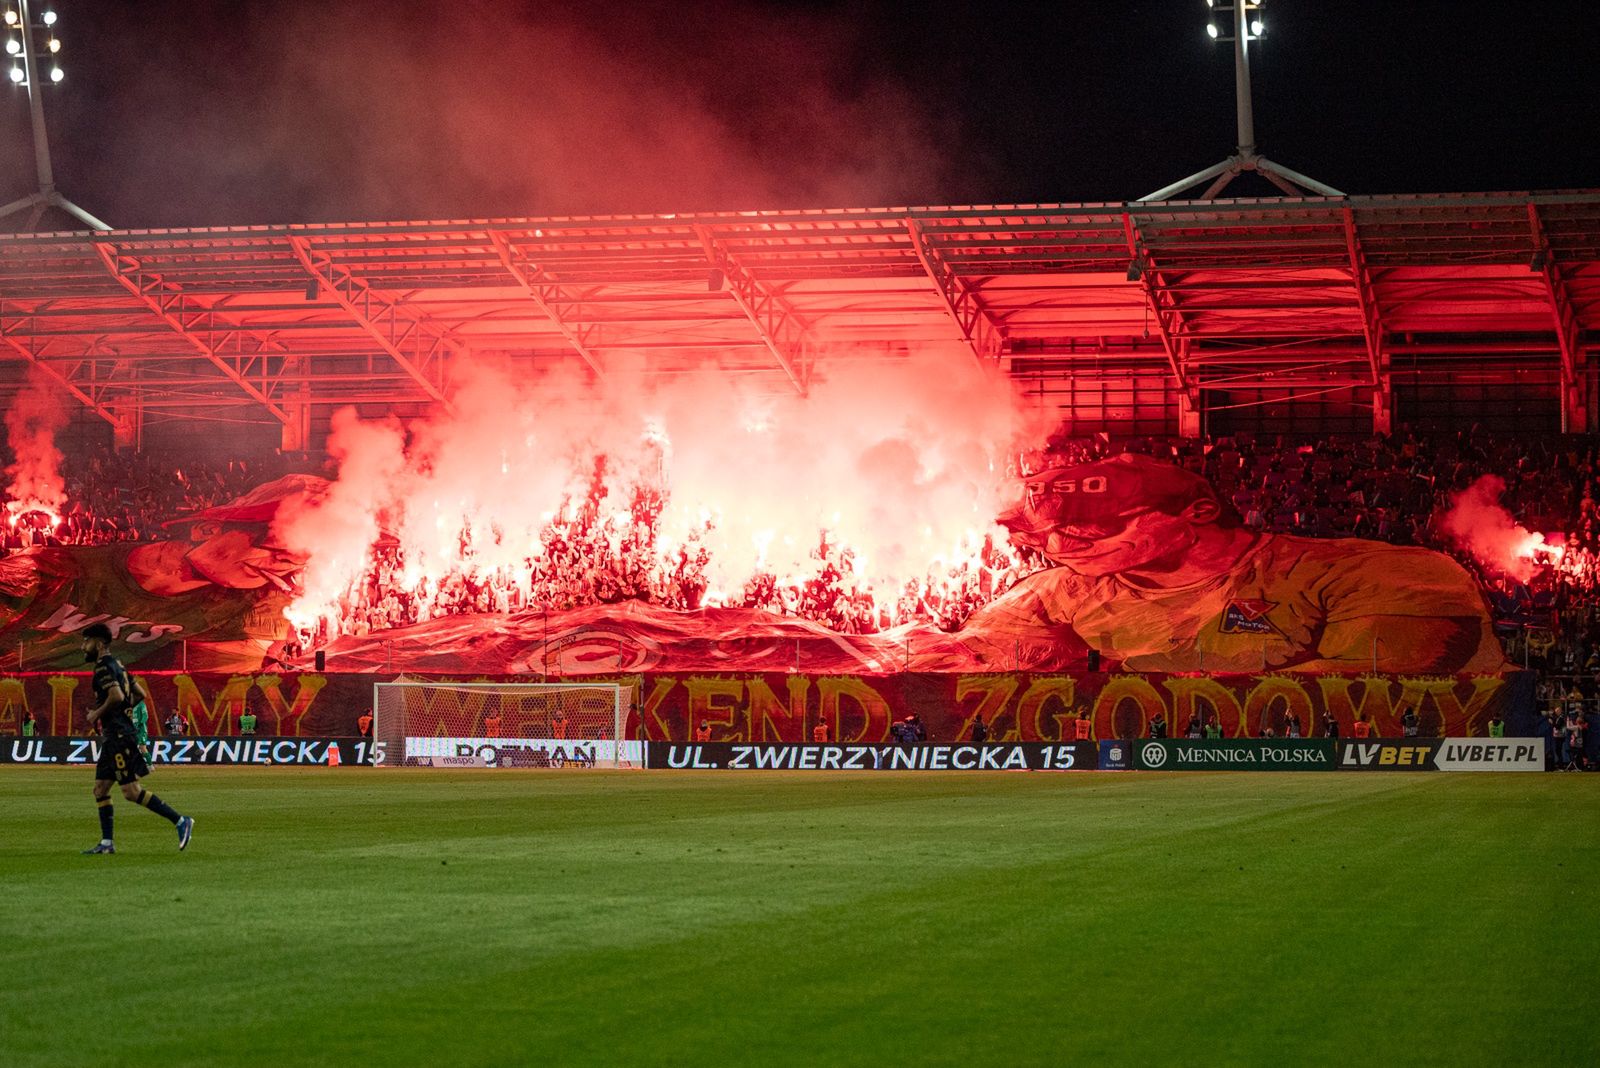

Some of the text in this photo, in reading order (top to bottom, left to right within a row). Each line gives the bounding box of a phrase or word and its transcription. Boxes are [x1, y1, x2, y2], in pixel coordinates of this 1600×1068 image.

[955, 673, 1503, 742] ZGODOWY
[11, 740, 57, 762] UL.
[355, 741, 387, 764] 15
[114, 753, 126, 769] 8
[667, 745, 1076, 770] UL. ZWIERZYNIECKA 15
[1176, 746, 1327, 762] MENNICA POLSKA
[1445, 745, 1538, 763] LVBET.PL
